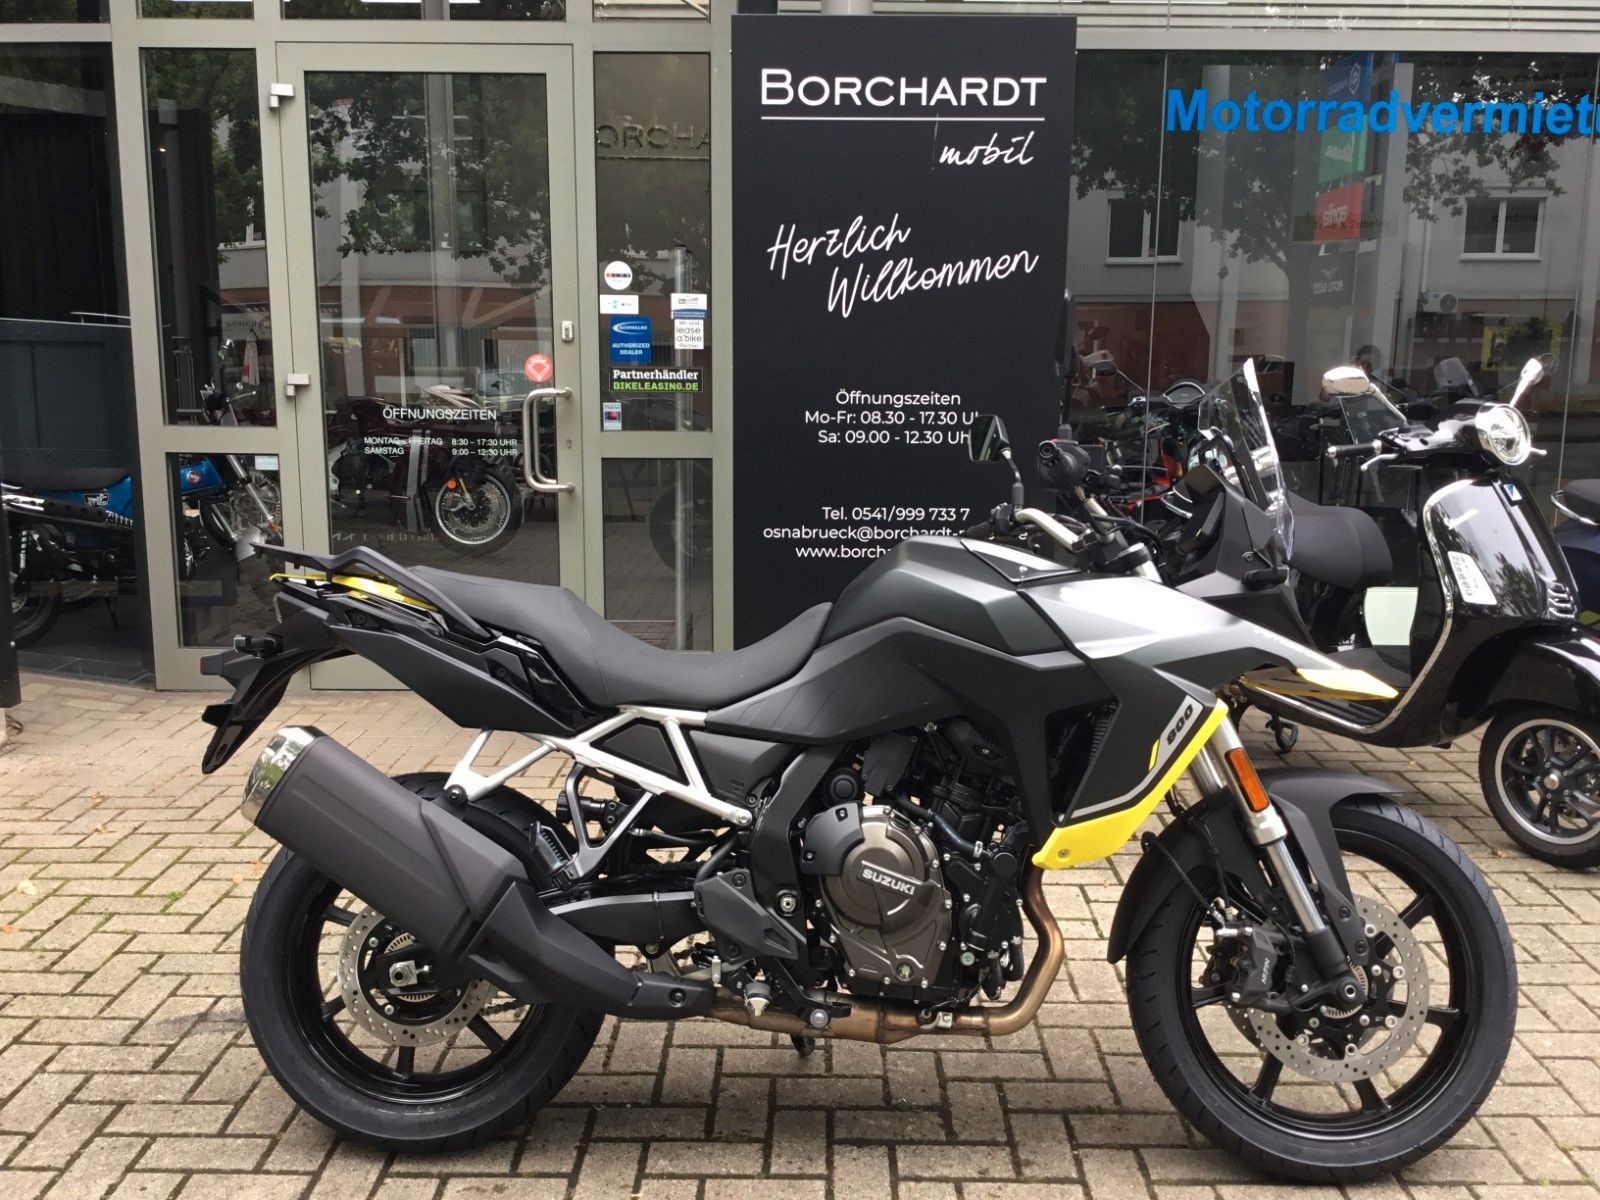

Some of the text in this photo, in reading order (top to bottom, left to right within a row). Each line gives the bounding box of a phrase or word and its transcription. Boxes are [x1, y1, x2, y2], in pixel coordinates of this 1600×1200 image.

[761, 67, 1047, 107] BORCHARDT
[1166, 88, 1600, 136] Motorradvermiet
[939, 131, 1035, 165] mobil
[767, 212, 911, 280] Herzlich
[827, 249, 1039, 318] Willkommen
[676, 326, 702, 334] lease
[684, 334, 703, 342] bike
[613, 369, 699, 380] Partnerhändler
[613, 382, 699, 391] BIKELEASING.DE
[835, 388, 961, 408] Öffnungszeiten
[382, 405, 497, 421] ÖFFNUNGSZEITEN
[805, 410, 857, 425] Mo-Fr:
[860, 410, 905, 425] 08.30
[919, 411, 958, 425] 17.30
[363, 437, 400, 445] MONTAG
[408, 437, 443, 445] FREITAG
[451, 438, 469, 446] 8:30
[476, 438, 498, 446] 17:30
[499, 438, 518, 446] UHR
[818, 430, 841, 444] Sa:
[845, 430, 890, 444] 09.00
[904, 430, 943, 444] 12.30
[948, 430, 971, 444] Uh
[364, 447, 404, 455] SAMSTAG
[452, 448, 469, 456] 9:00
[476, 448, 498, 456] 12:30
[821, 505, 970, 522] Tel. 0541/999 733 7
[763, 525, 966, 542] osnabrueck@borchardt-
[795, 544, 891, 558] www.borch
[1166, 704, 1193, 745] 800
[862, 868, 916, 895] SUZUKI
